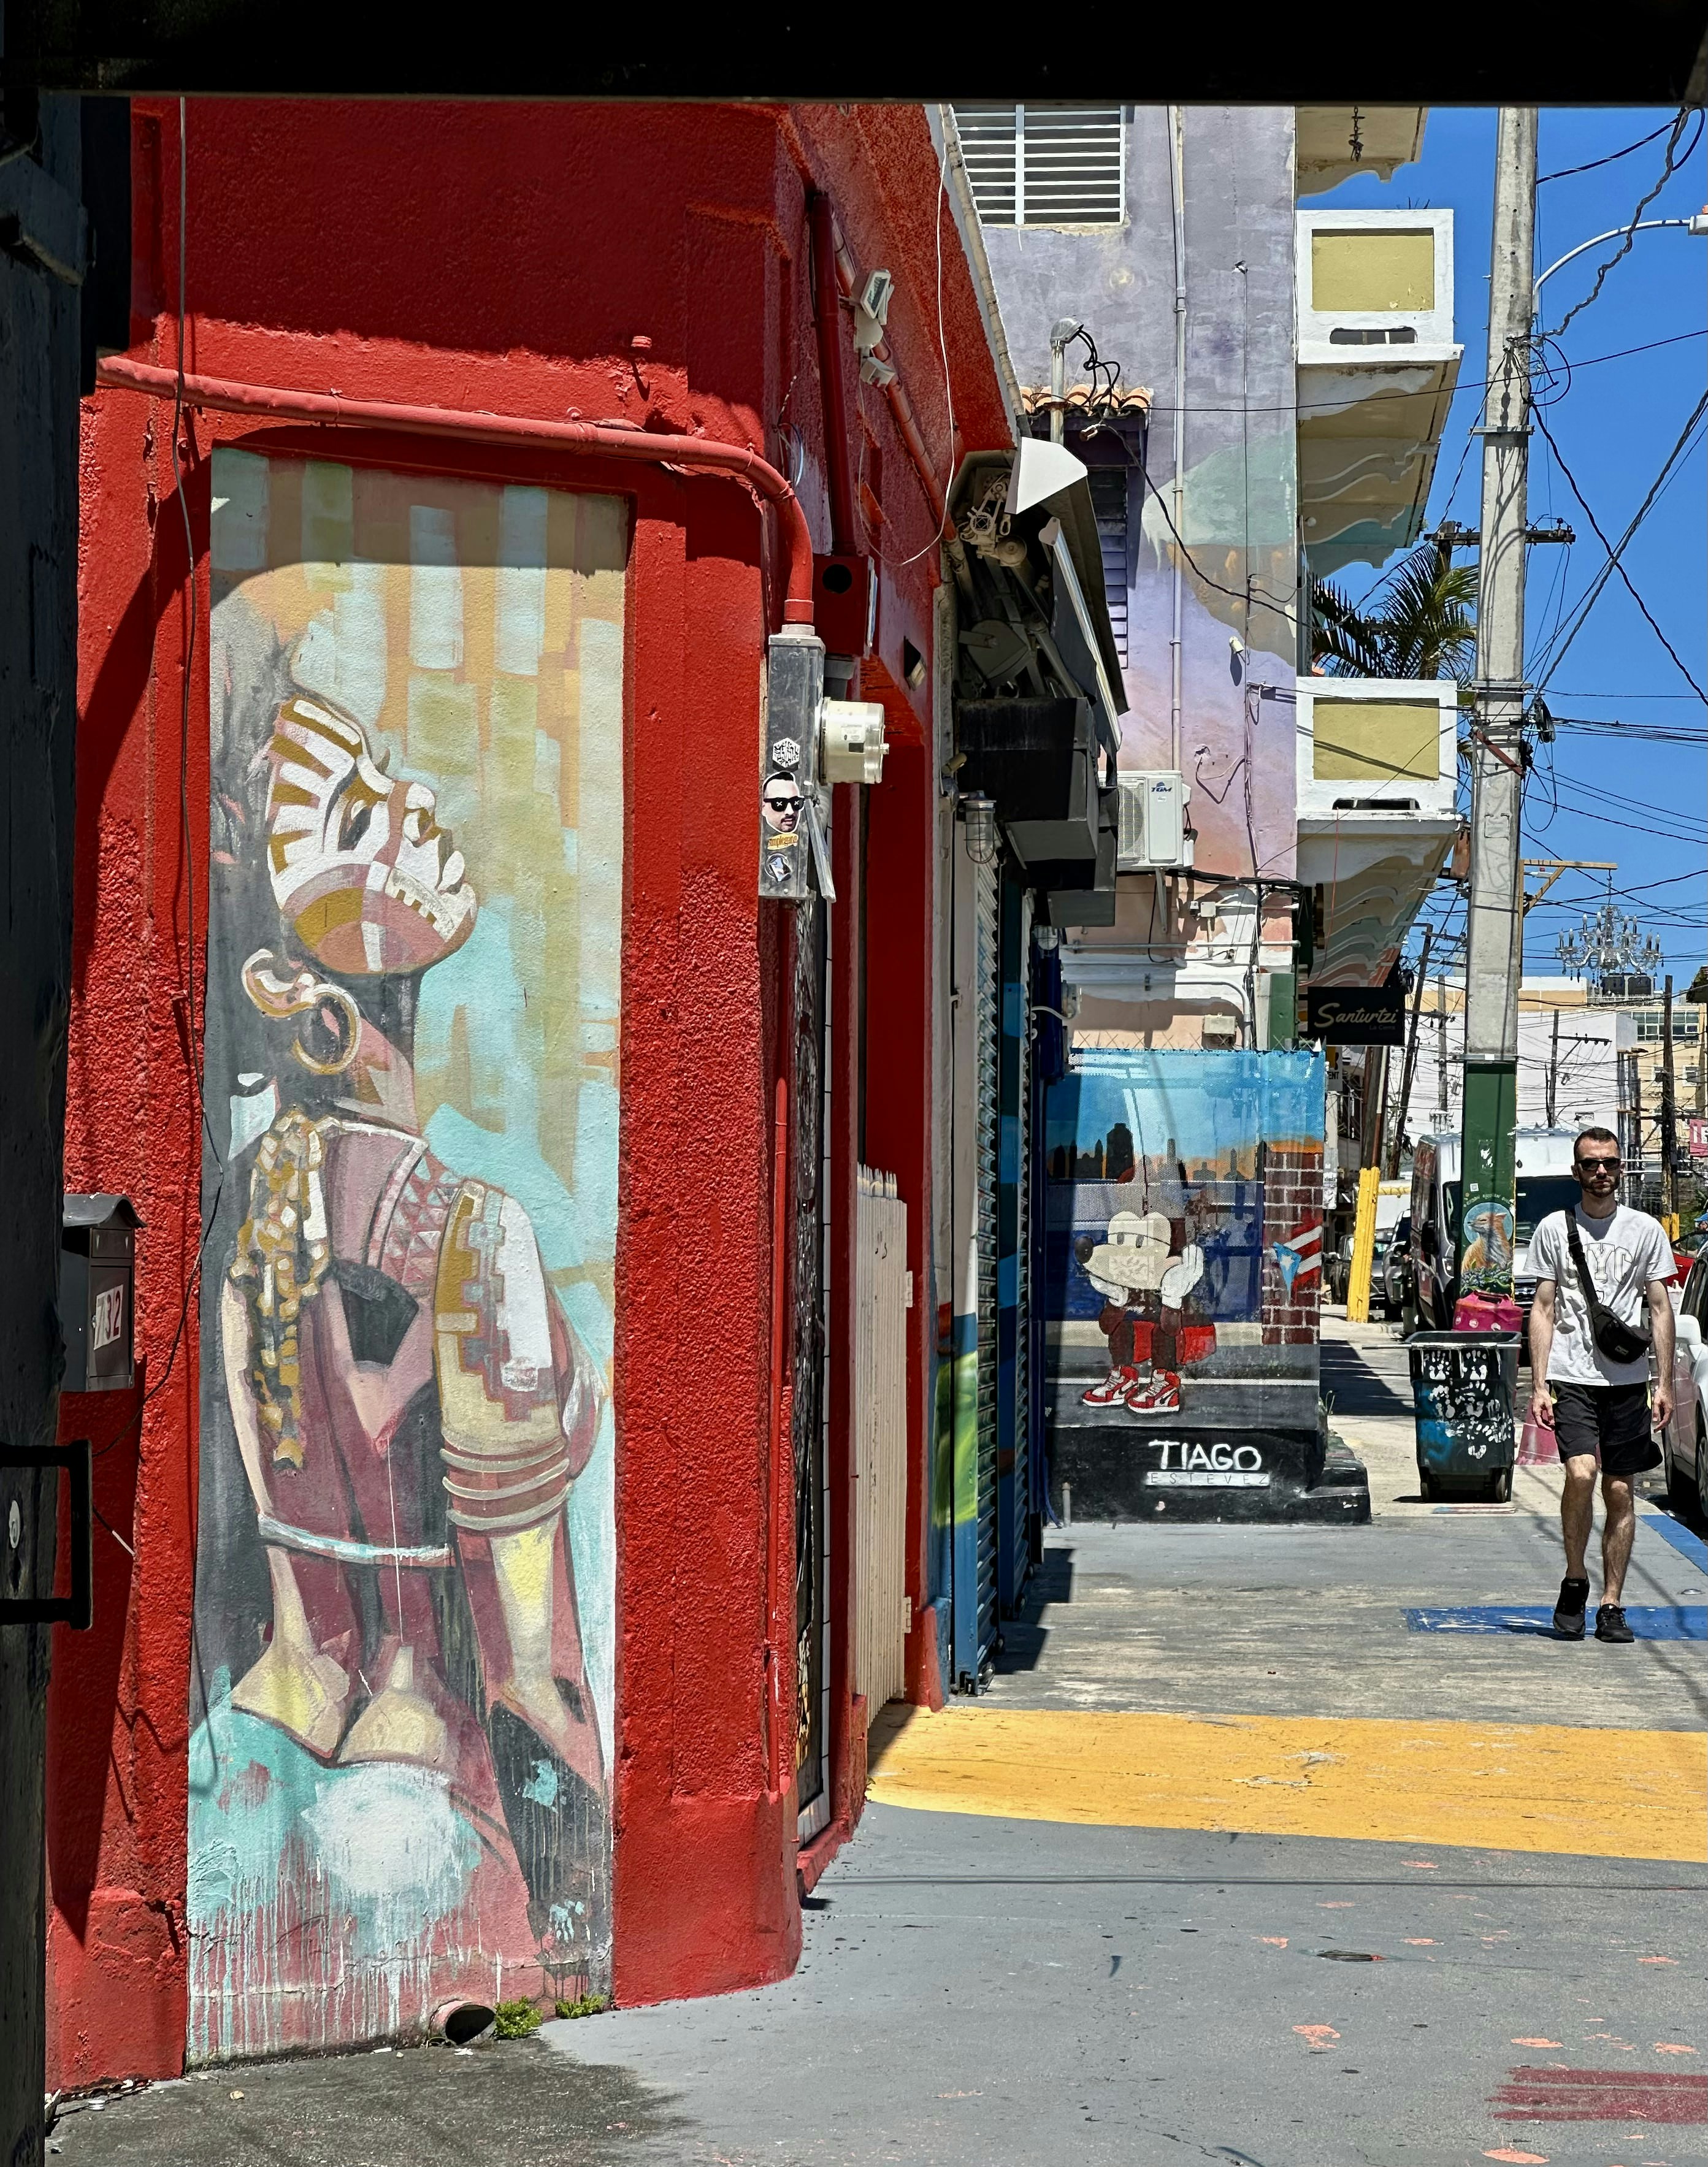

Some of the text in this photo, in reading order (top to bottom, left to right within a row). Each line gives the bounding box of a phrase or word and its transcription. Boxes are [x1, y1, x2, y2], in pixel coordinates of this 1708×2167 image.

[1314, 1002, 1399, 1028] Santurtzi
[96, 1290, 121, 1345] 732
[1148, 1439, 1262, 1470] TIAGO
[1151, 1472, 1269, 1485] ESTEVEZ
